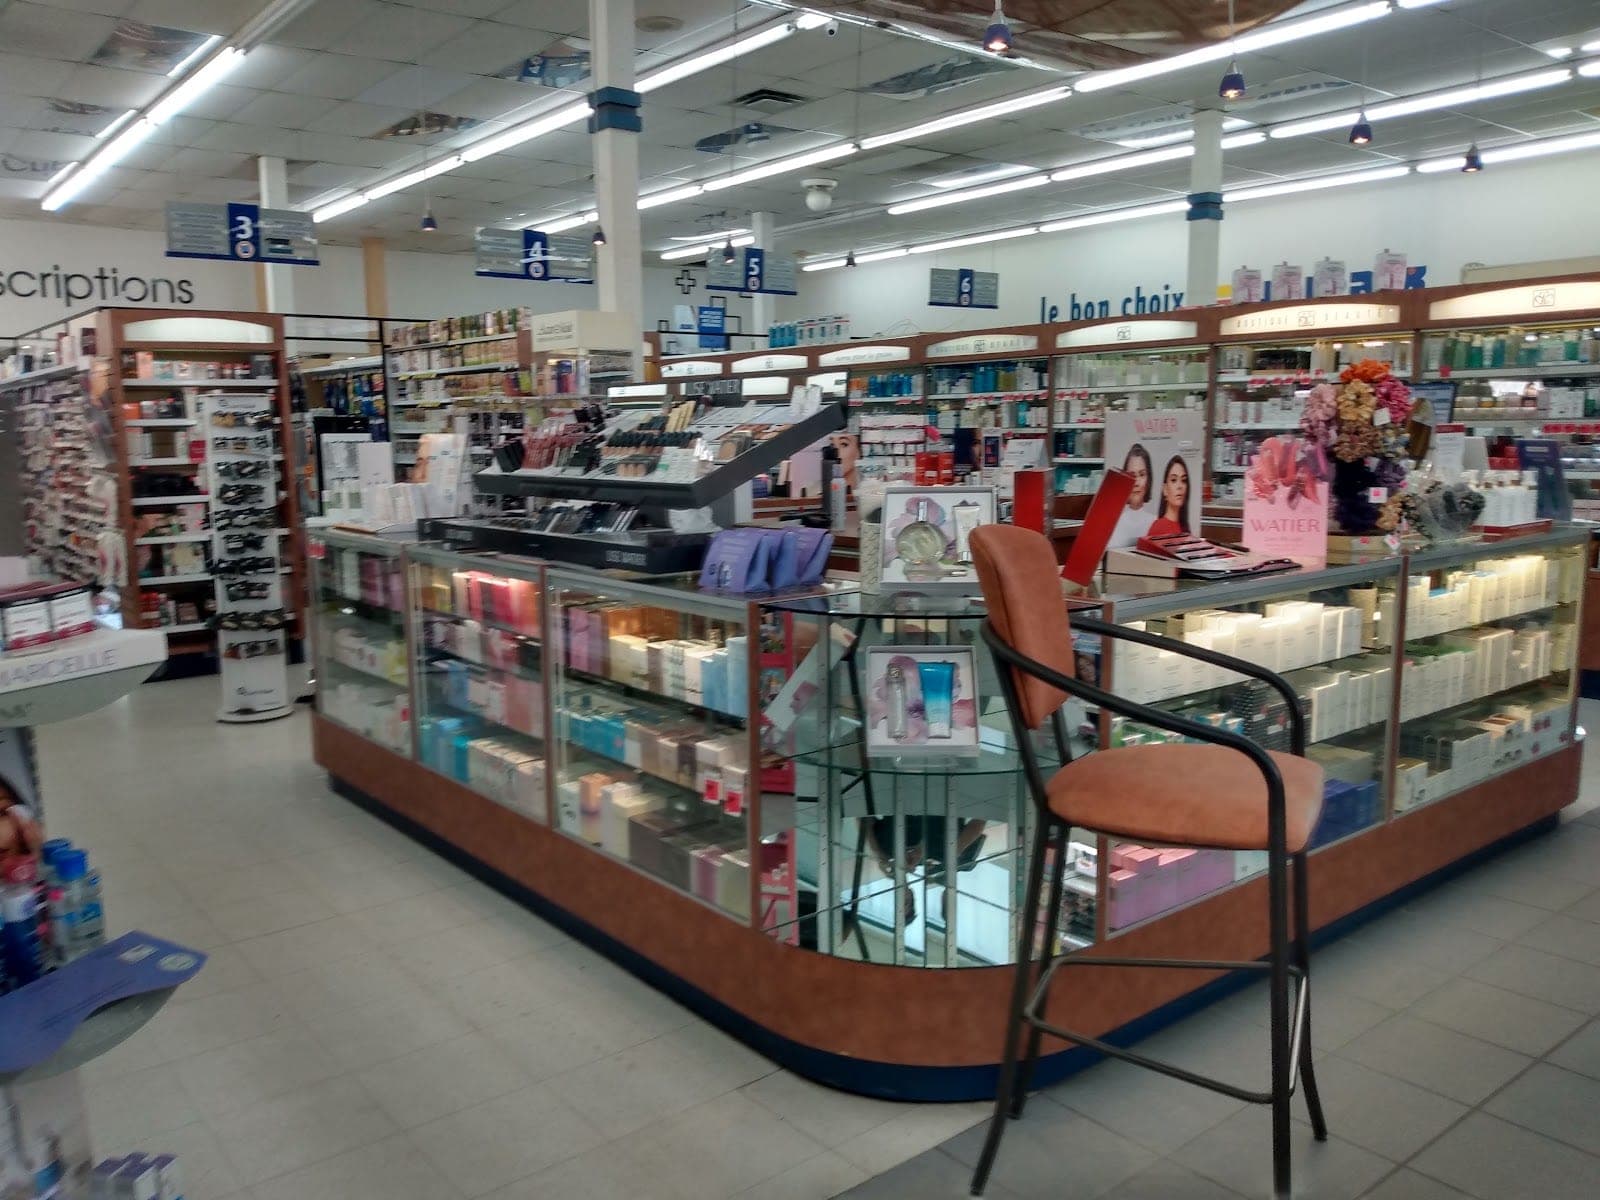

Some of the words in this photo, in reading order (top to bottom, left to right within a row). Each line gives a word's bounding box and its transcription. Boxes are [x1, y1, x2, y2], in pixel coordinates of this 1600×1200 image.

[235, 215, 252, 239] 3
[529, 241, 543, 261] 4
[749, 257, 760, 275] 5
[961, 277, 971, 292] 6
[1041, 296, 1059, 324] le
[1070, 293, 1110, 321] bon
[1121, 284, 1184, 316] choix
[1250, 518, 1321, 533] WATIER
